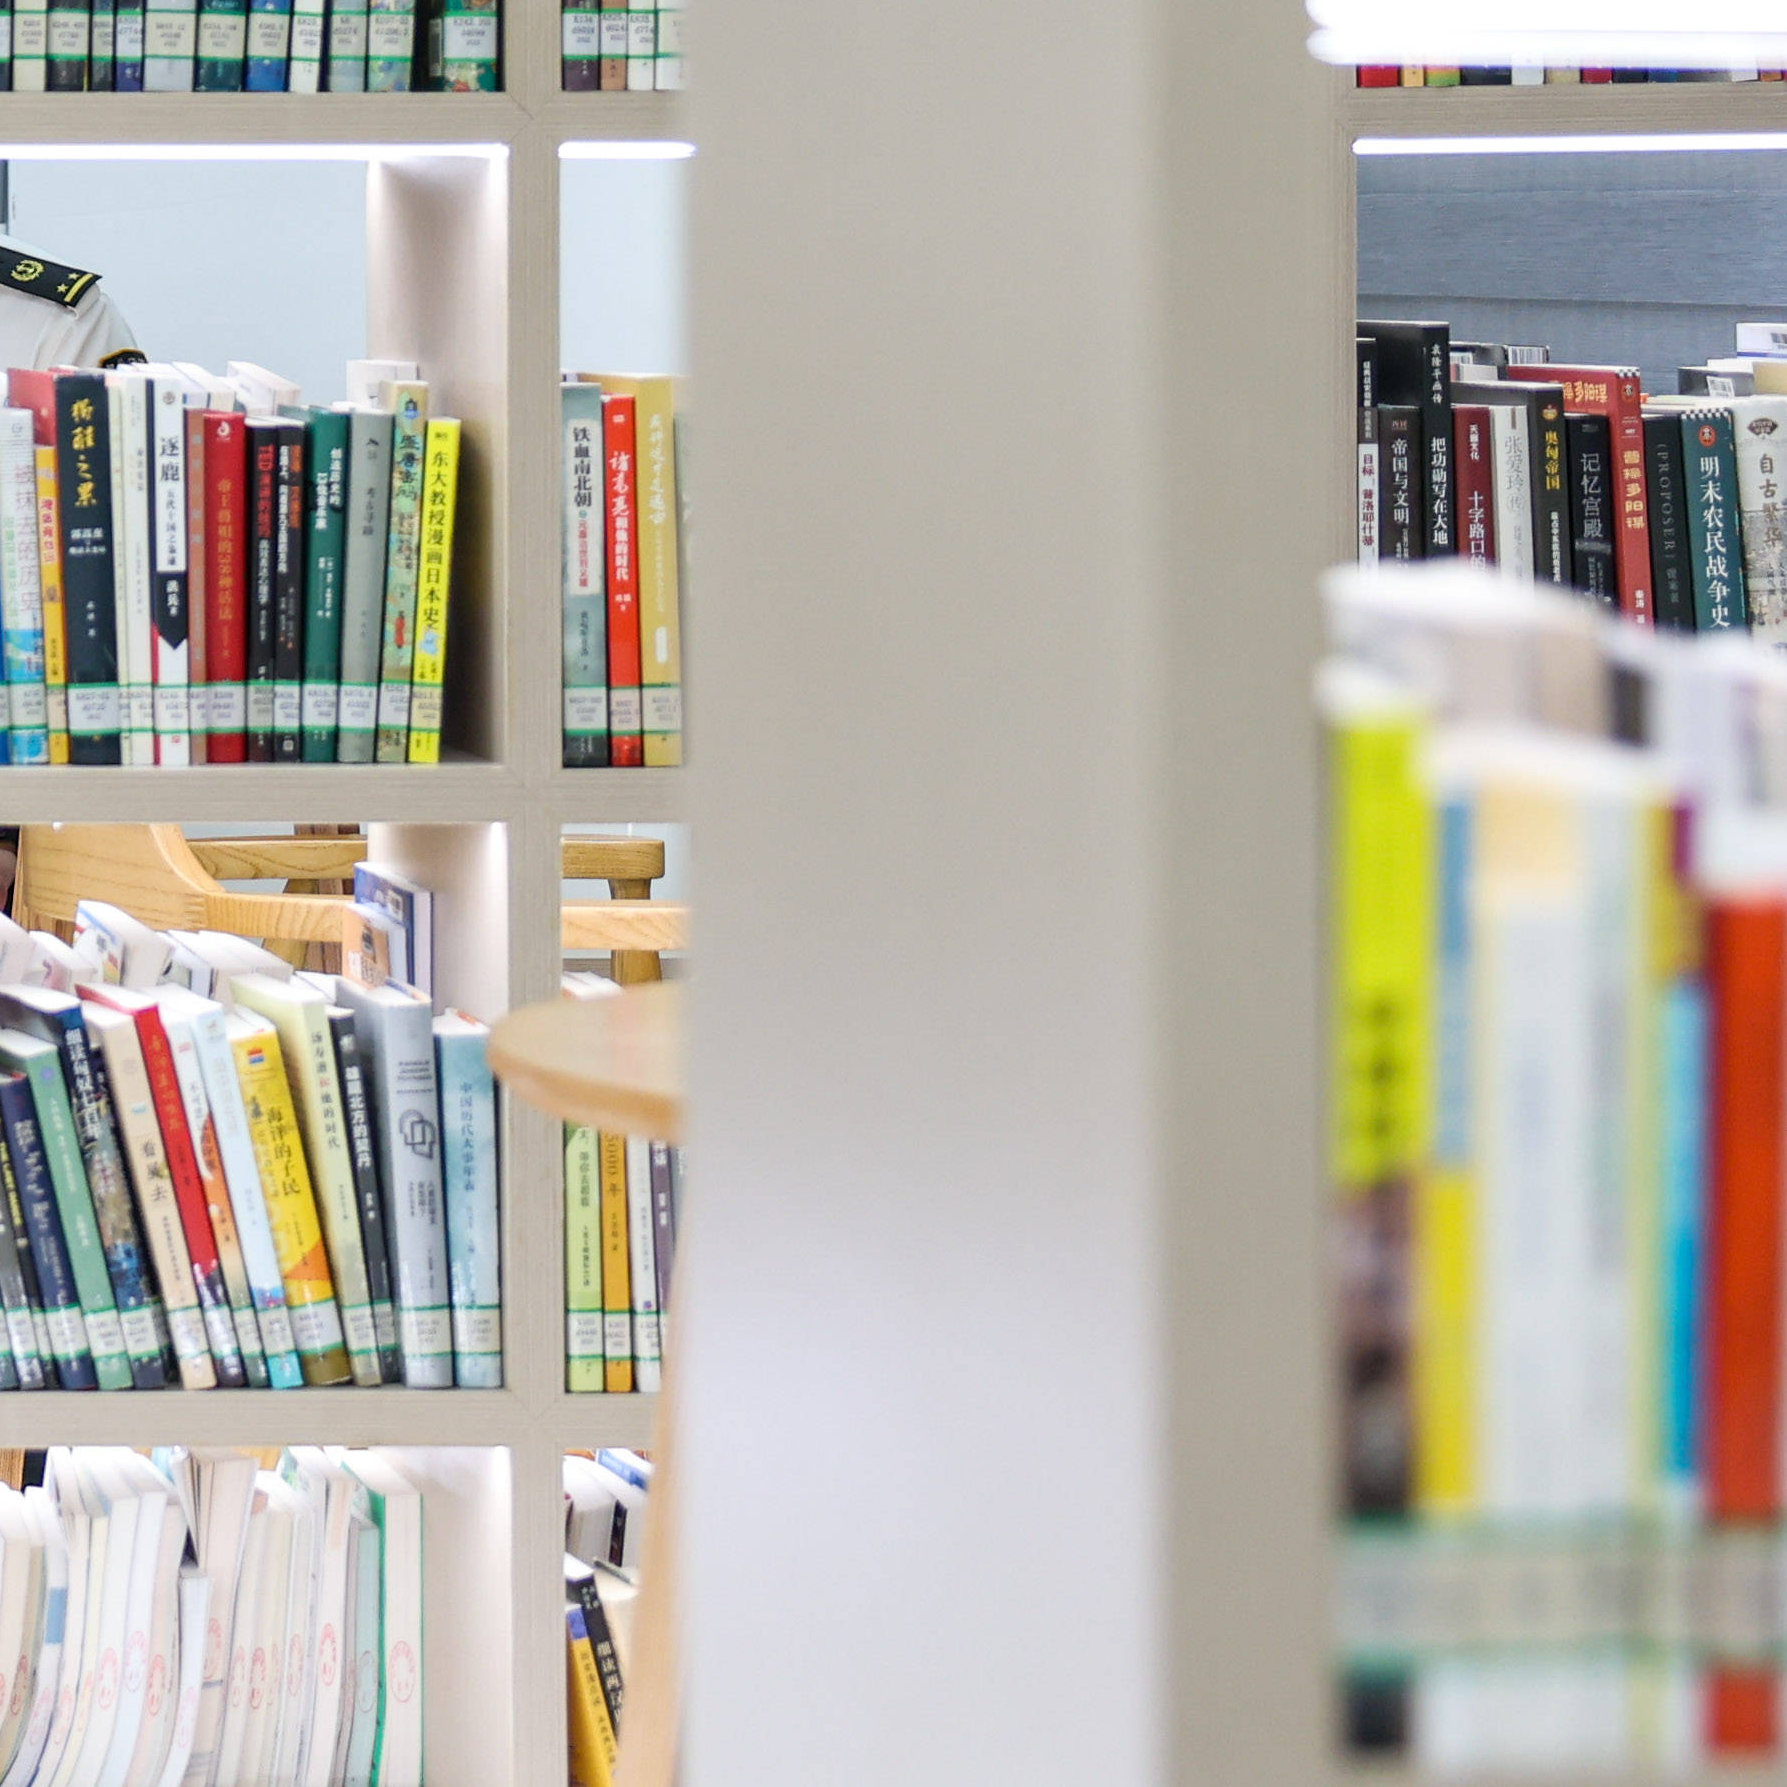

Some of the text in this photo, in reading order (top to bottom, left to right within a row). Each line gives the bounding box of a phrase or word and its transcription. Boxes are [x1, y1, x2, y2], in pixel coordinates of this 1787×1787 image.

[1431, 343, 1443, 405] 袁隆平画传
[572, 426, 593, 508] 铁血南北朝
[608, 449, 631, 516] 诸葛亮
[1361, 453, 1375, 547] 目标 普洛耶什蒂
[1391, 438, 1410, 524] 帝国与文明
[1430, 436, 1449, 545] 把功勋写在大地
[1544, 430, 1562, 491] 奥匈帝国
[1580, 453, 1604, 539] 记忆宫殿
[1623, 450, 1646, 530] 曹操多阳谋
[1758, 453, 1783, 548] 自古繁华
[423, 451, 449, 624] 东大教授漫画日本史
[1699, 456, 1731, 629] 明末农民战争史
[459, 1081, 476, 1192] 中国历代大事年表
